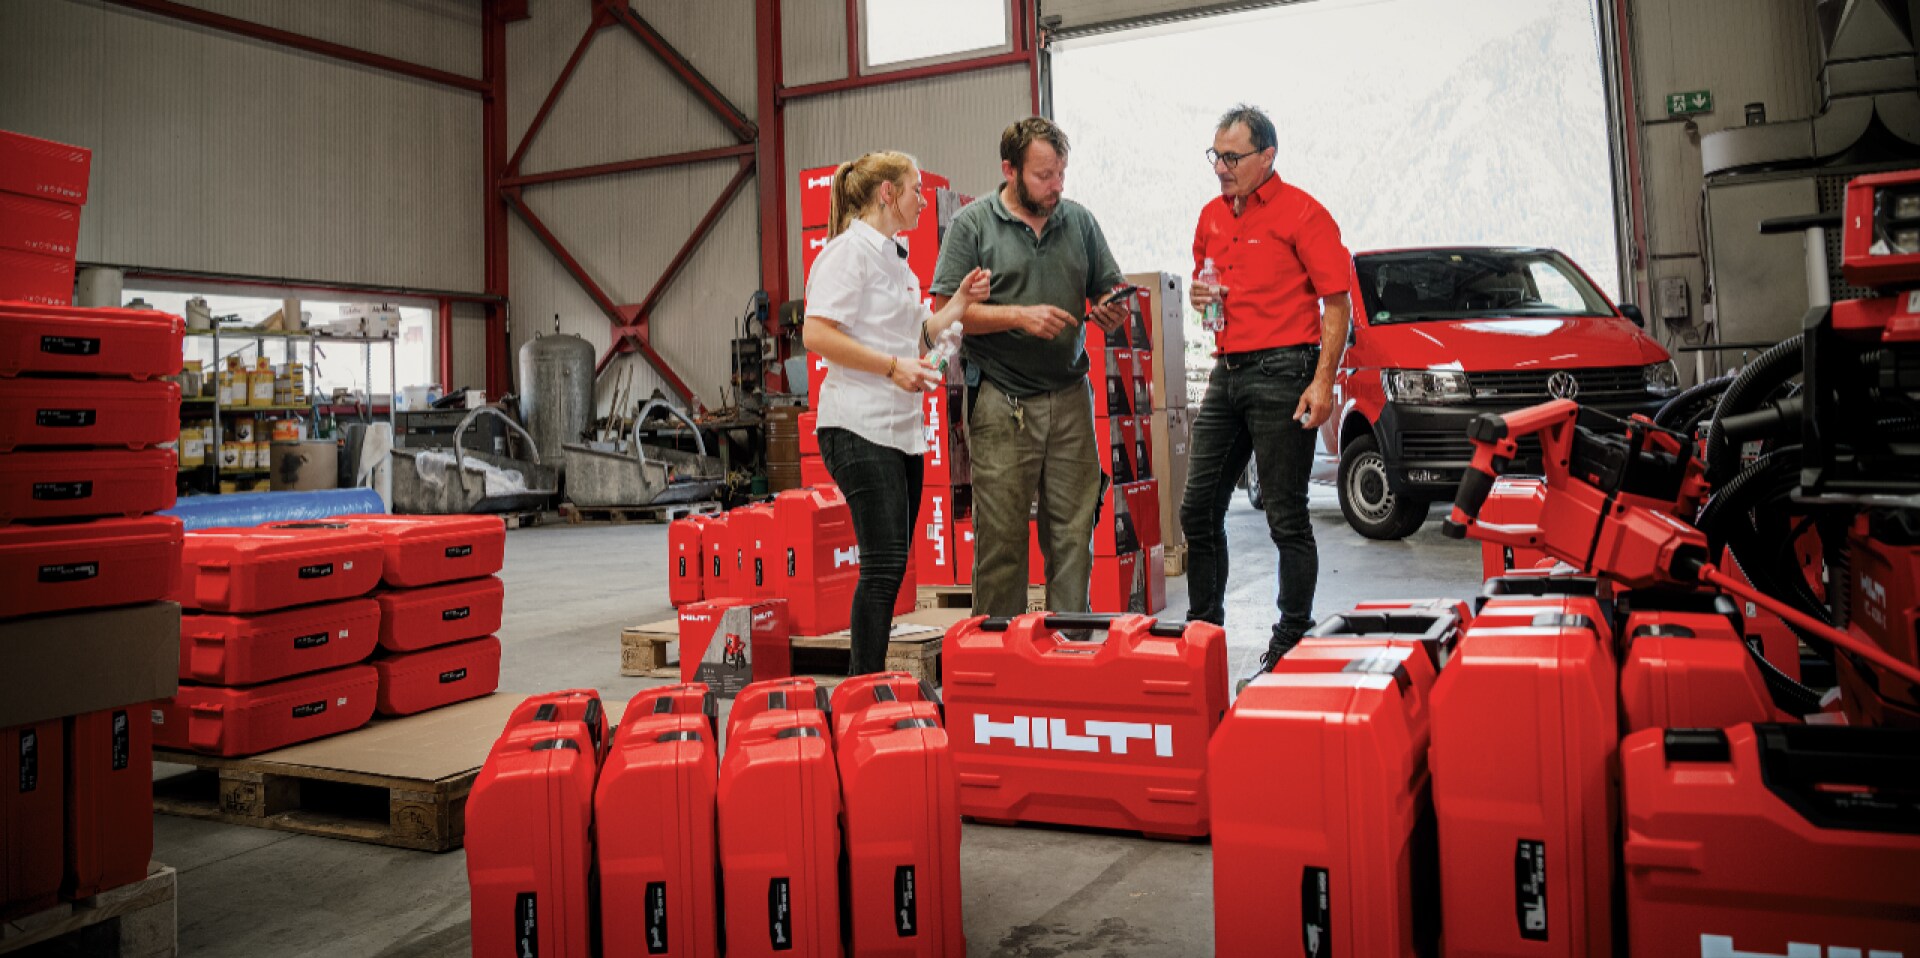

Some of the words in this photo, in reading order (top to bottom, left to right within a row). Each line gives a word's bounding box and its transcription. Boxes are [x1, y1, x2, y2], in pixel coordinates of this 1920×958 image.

[927, 397, 942, 466] HILTI
[932, 496, 946, 566] HILTI
[680, 613, 711, 621] HILTI
[754, 610, 773, 621] HILTI
[973, 713, 1173, 757] HILTI
